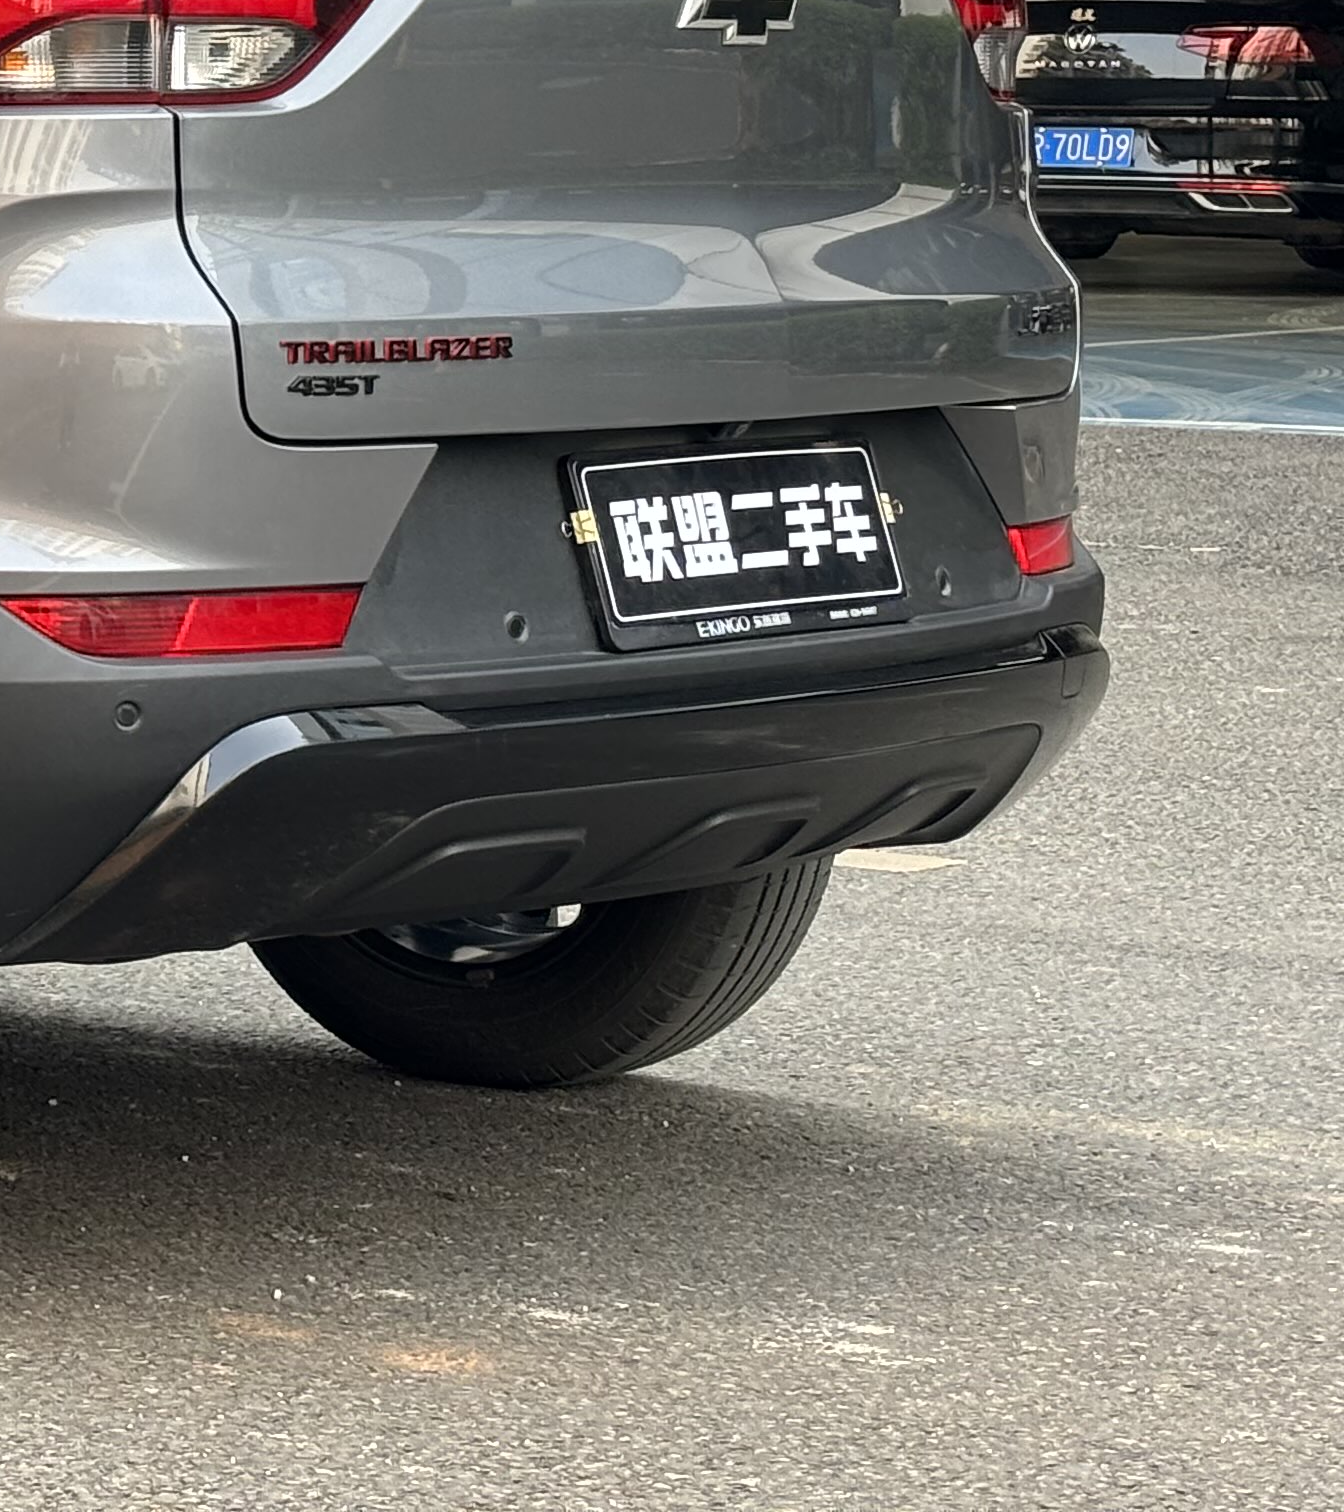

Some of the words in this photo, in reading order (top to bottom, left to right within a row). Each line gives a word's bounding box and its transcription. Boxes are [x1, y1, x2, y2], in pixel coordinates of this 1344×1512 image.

[280, 334, 514, 365] TRAILBLAZER
[287, 374, 380, 396] 435T
[609, 482, 878, 583] 联盟二手车
